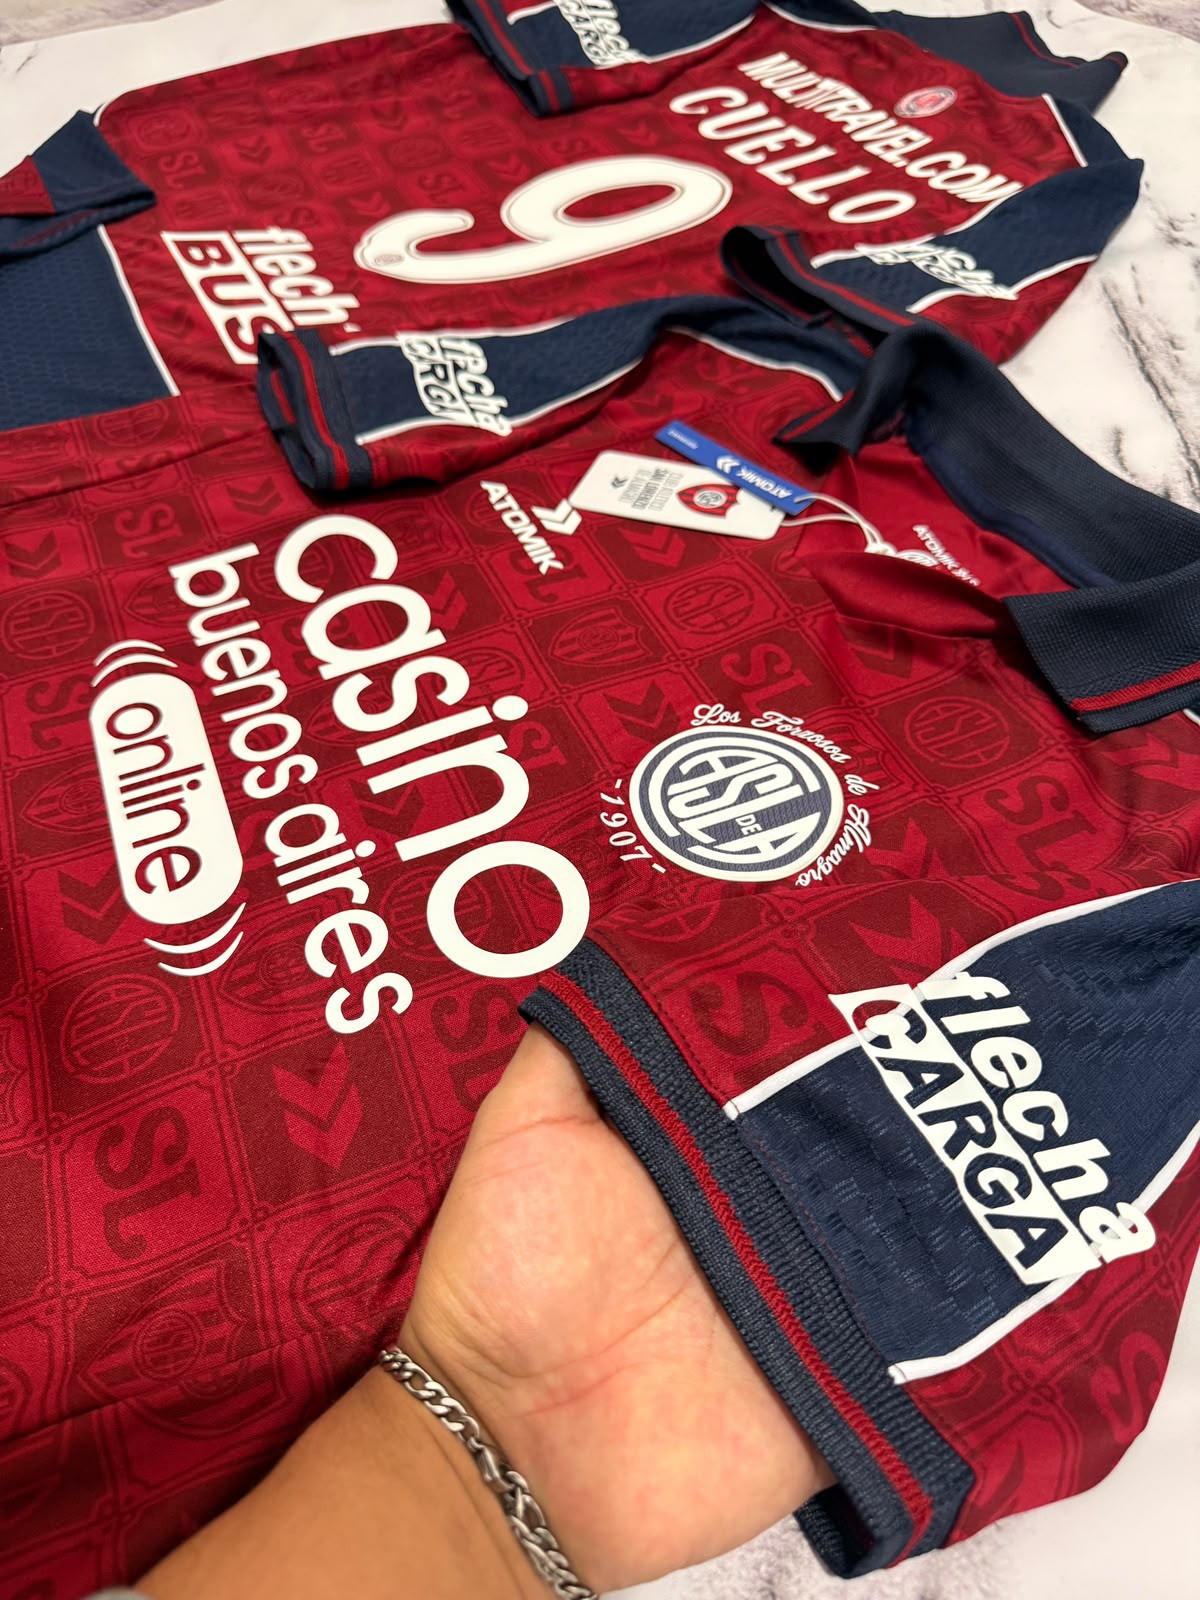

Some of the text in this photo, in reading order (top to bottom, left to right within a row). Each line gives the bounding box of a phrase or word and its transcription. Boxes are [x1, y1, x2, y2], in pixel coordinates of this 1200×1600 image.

[669, 86, 916, 224] CUELLO
[738, 51, 1024, 203] MULTITRAVEL.COM
[353, 154, 733, 284] 9
[173, 240, 287, 354] BUS
[232, 227, 361, 333] flech
[480, 480, 565, 575] ATOMIK
[736, 466, 793, 499] ATOMIK
[912, 524, 961, 571] ATOMIK
[274, 514, 590, 979] casino
[690, 703, 742, 728] Los
[106, 701, 206, 895] online
[168, 542, 413, 1034] buenos aires
[735, 812, 761, 836] DE
[844, 772, 880, 796] de
[795, 803, 873, 888] Almagro
[851, 999, 1069, 1271] CARGA
[917, 971, 1157, 1264] flecha
